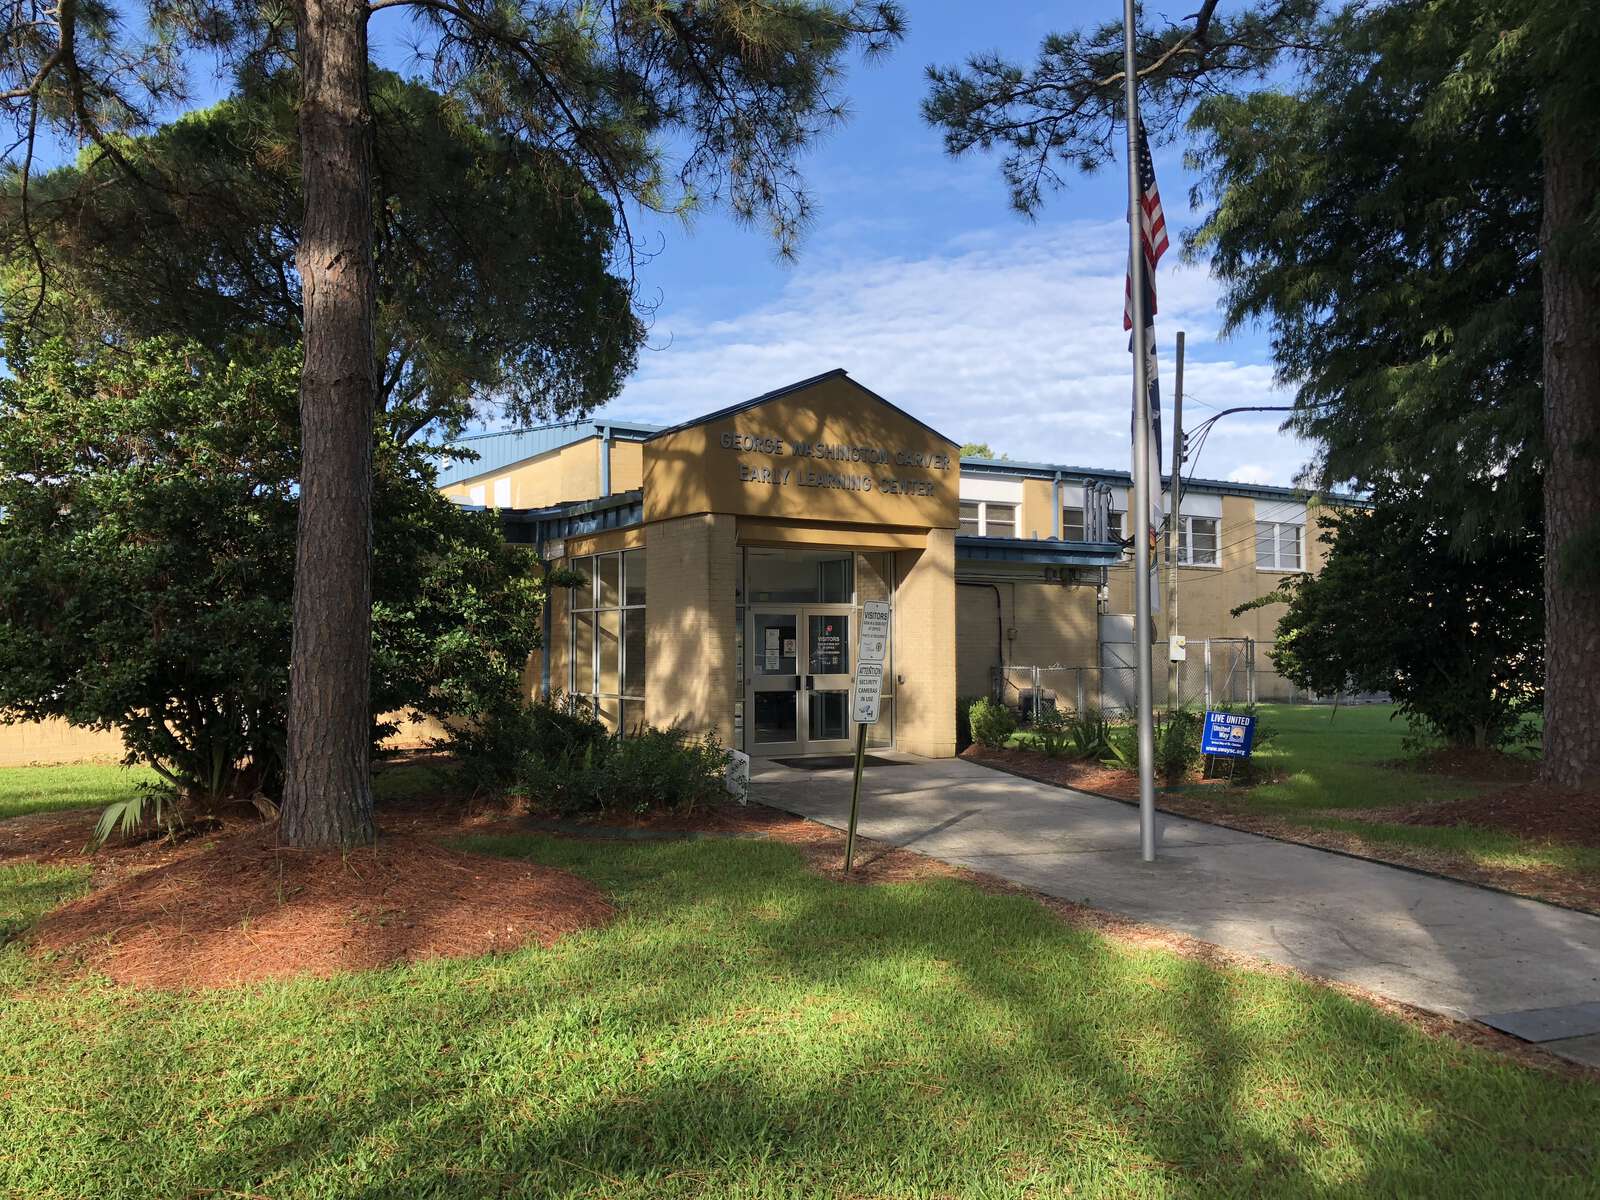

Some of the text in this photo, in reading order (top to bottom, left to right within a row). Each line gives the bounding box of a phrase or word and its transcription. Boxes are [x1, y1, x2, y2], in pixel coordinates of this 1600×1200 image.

[720, 432, 951, 471] GEORGE WASHINGTON CARVER
[738, 464, 935, 497] EARLY LEARNING CENTER
[864, 611, 888, 620] VISITORS
[1211, 714, 1249, 725] LIVE UNITED
